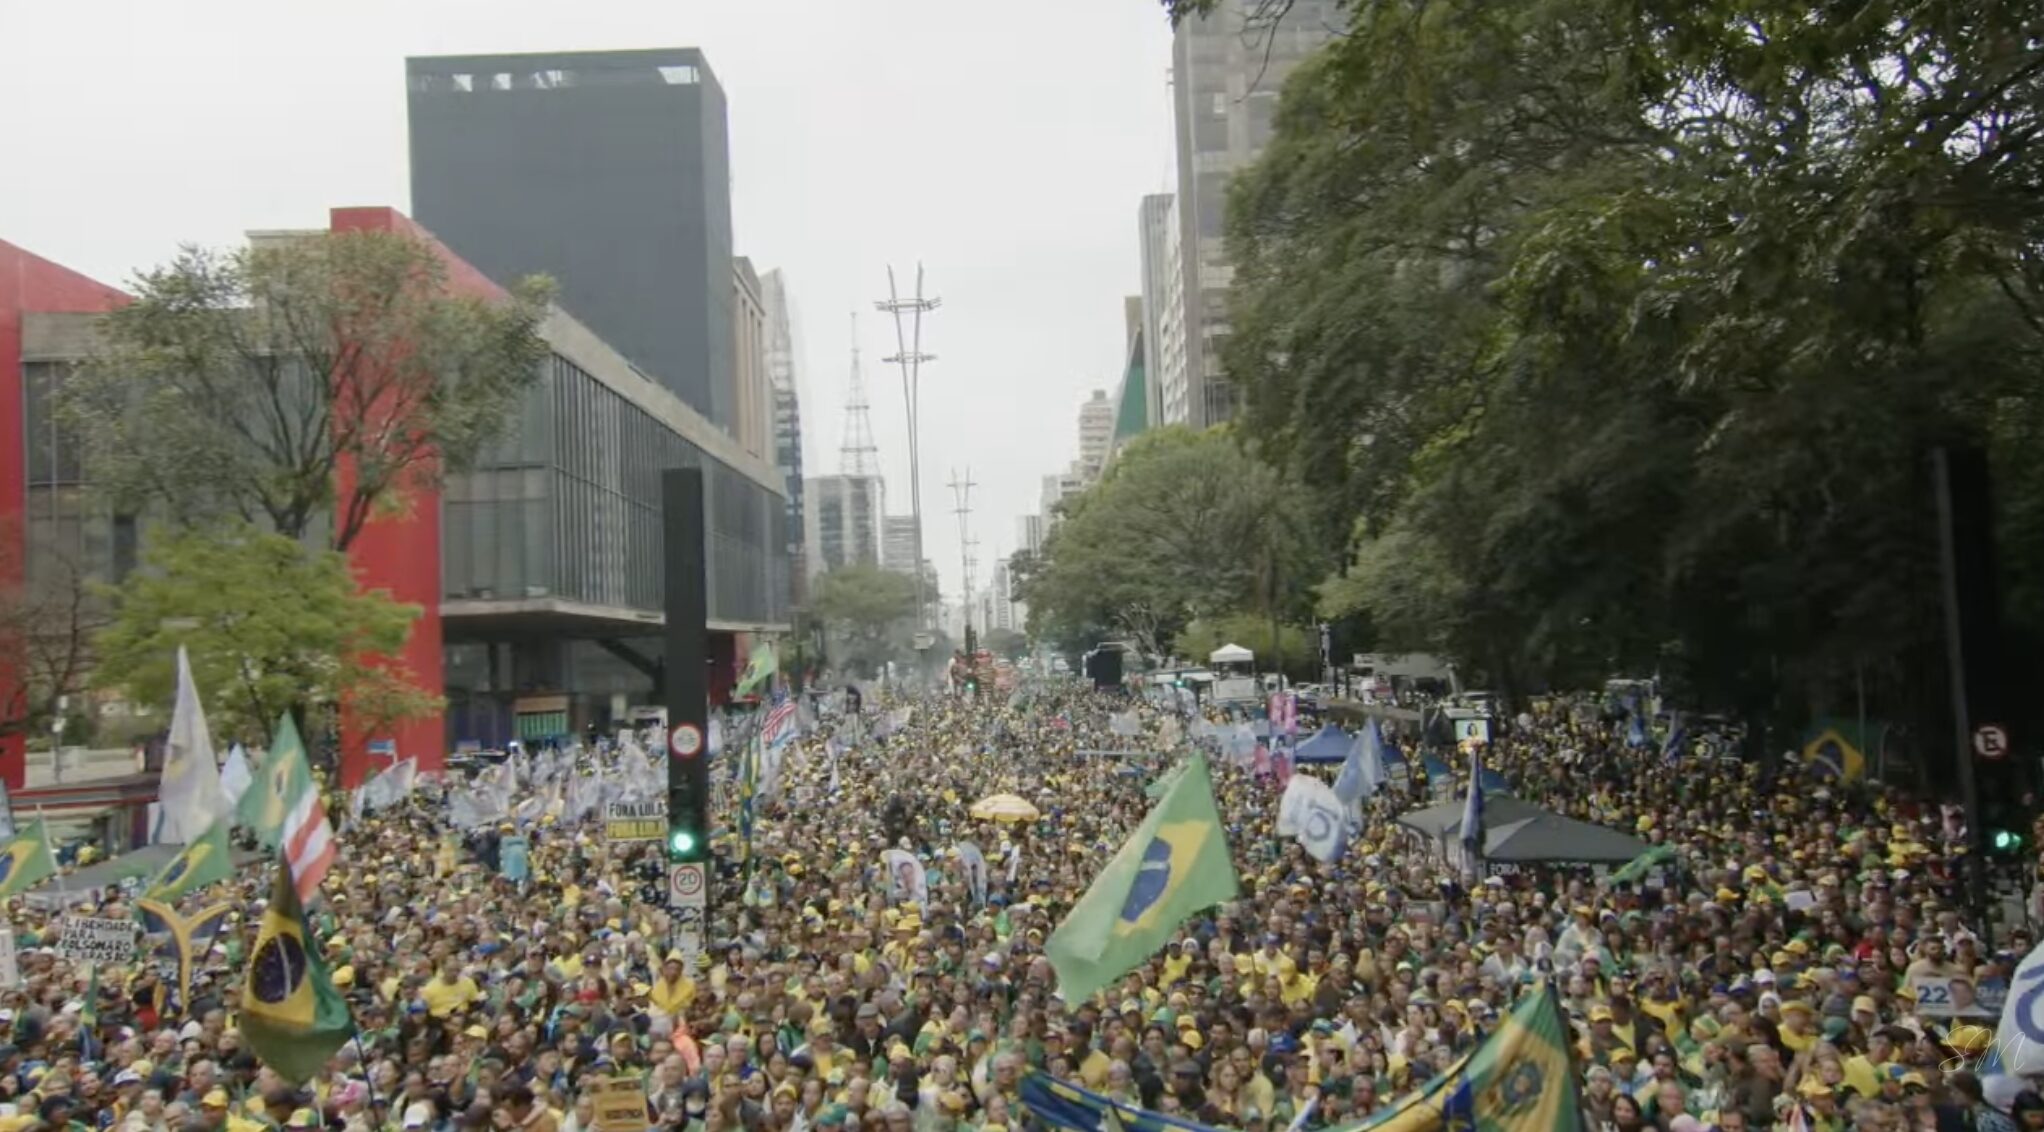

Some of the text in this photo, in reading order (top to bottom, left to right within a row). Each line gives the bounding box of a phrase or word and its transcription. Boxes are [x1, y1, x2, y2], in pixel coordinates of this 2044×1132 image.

[609, 802, 664, 817] FORA LULA
[1488, 863, 1520, 876] FORA
[680, 872, 697, 886] 20
[64, 929, 96, 939] PARA
[1916, 985, 1950, 1004] 22
